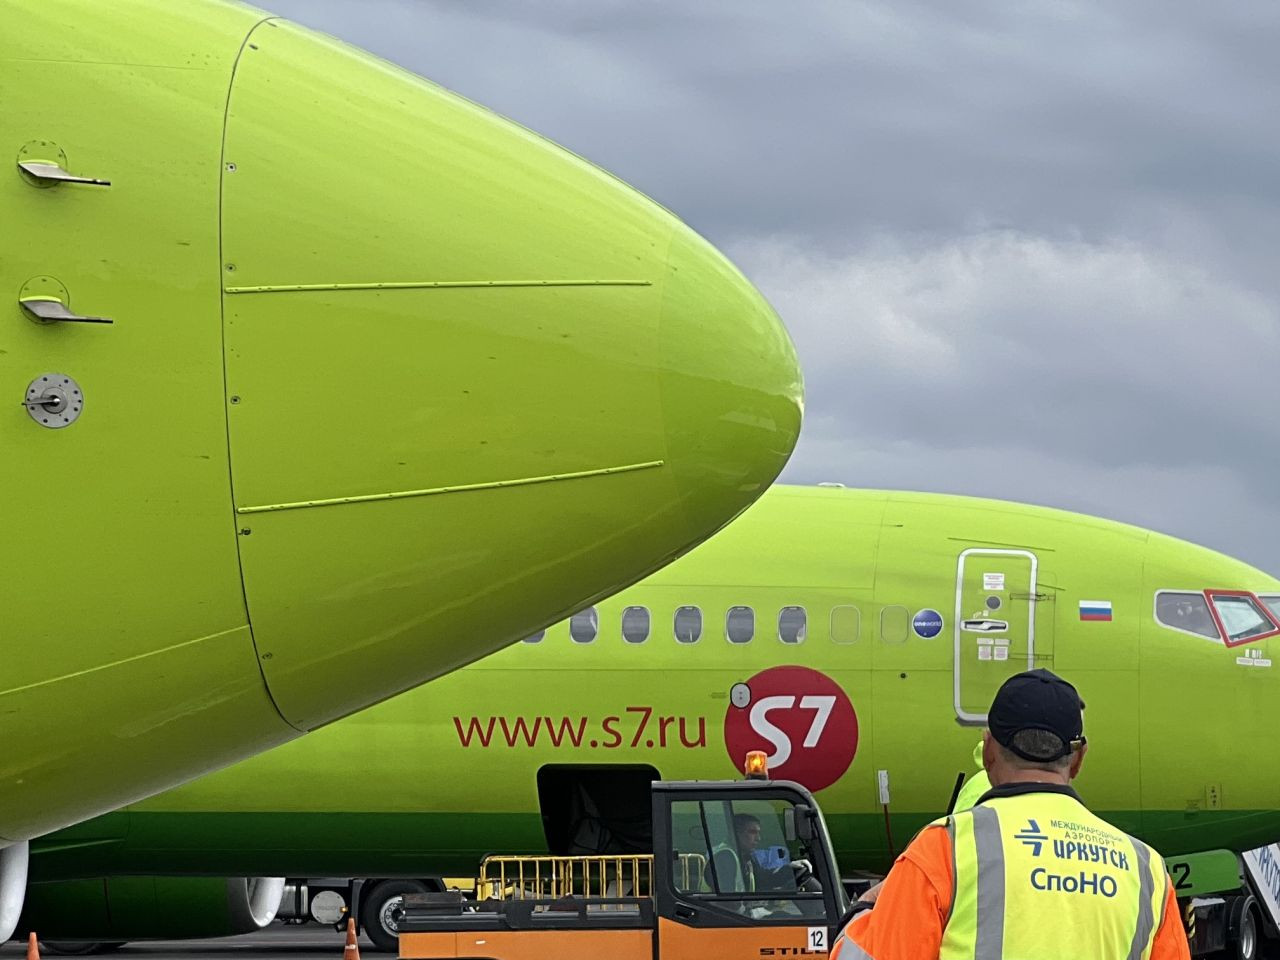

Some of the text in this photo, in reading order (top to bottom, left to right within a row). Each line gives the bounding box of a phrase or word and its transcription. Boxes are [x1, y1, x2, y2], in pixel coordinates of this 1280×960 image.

[452, 706, 707, 748] www.s7.ru
[749, 695, 837, 769] S7
[1064, 831, 1116, 847] АЭРОПОРТ
[1053, 839, 1129, 871] ИРКУТСК
[1030, 867, 1118, 898] СпоНО
[1166, 862, 1193, 889] 2
[810, 930, 823, 946] 12
